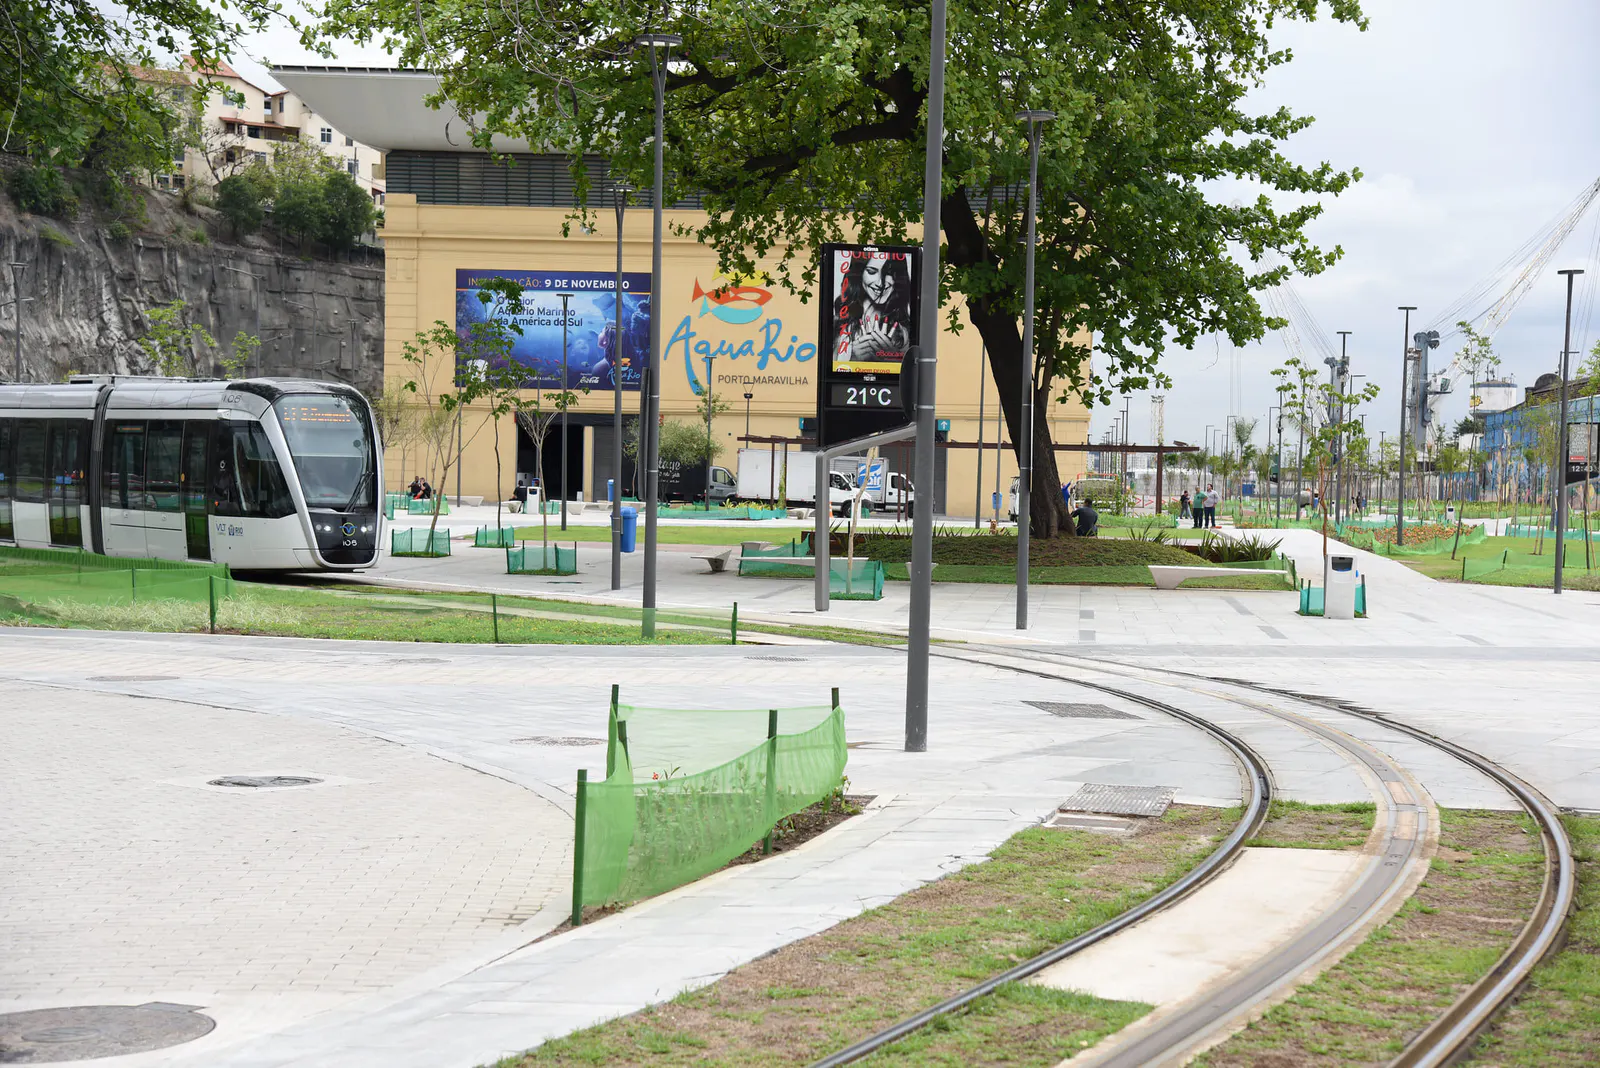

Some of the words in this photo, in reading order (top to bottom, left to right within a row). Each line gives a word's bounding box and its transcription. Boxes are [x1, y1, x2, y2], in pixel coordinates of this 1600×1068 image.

[544, 279, 552, 288] 9
[554, 279, 568, 288] DE
[571, 279, 630, 289] NOVEMBO
[508, 297, 535, 305] mior
[497, 306, 535, 317] Aqrio
[512, 317, 551, 326] América
[554, 318, 566, 326] do
[567, 318, 583, 327] Sul
[663, 315, 817, 396] AquaRio
[606, 366, 641, 386] AaRio
[717, 375, 750, 384] PORTO
[753, 375, 809, 386] MARAVILHA
[846, 387, 892, 406] 21°C
